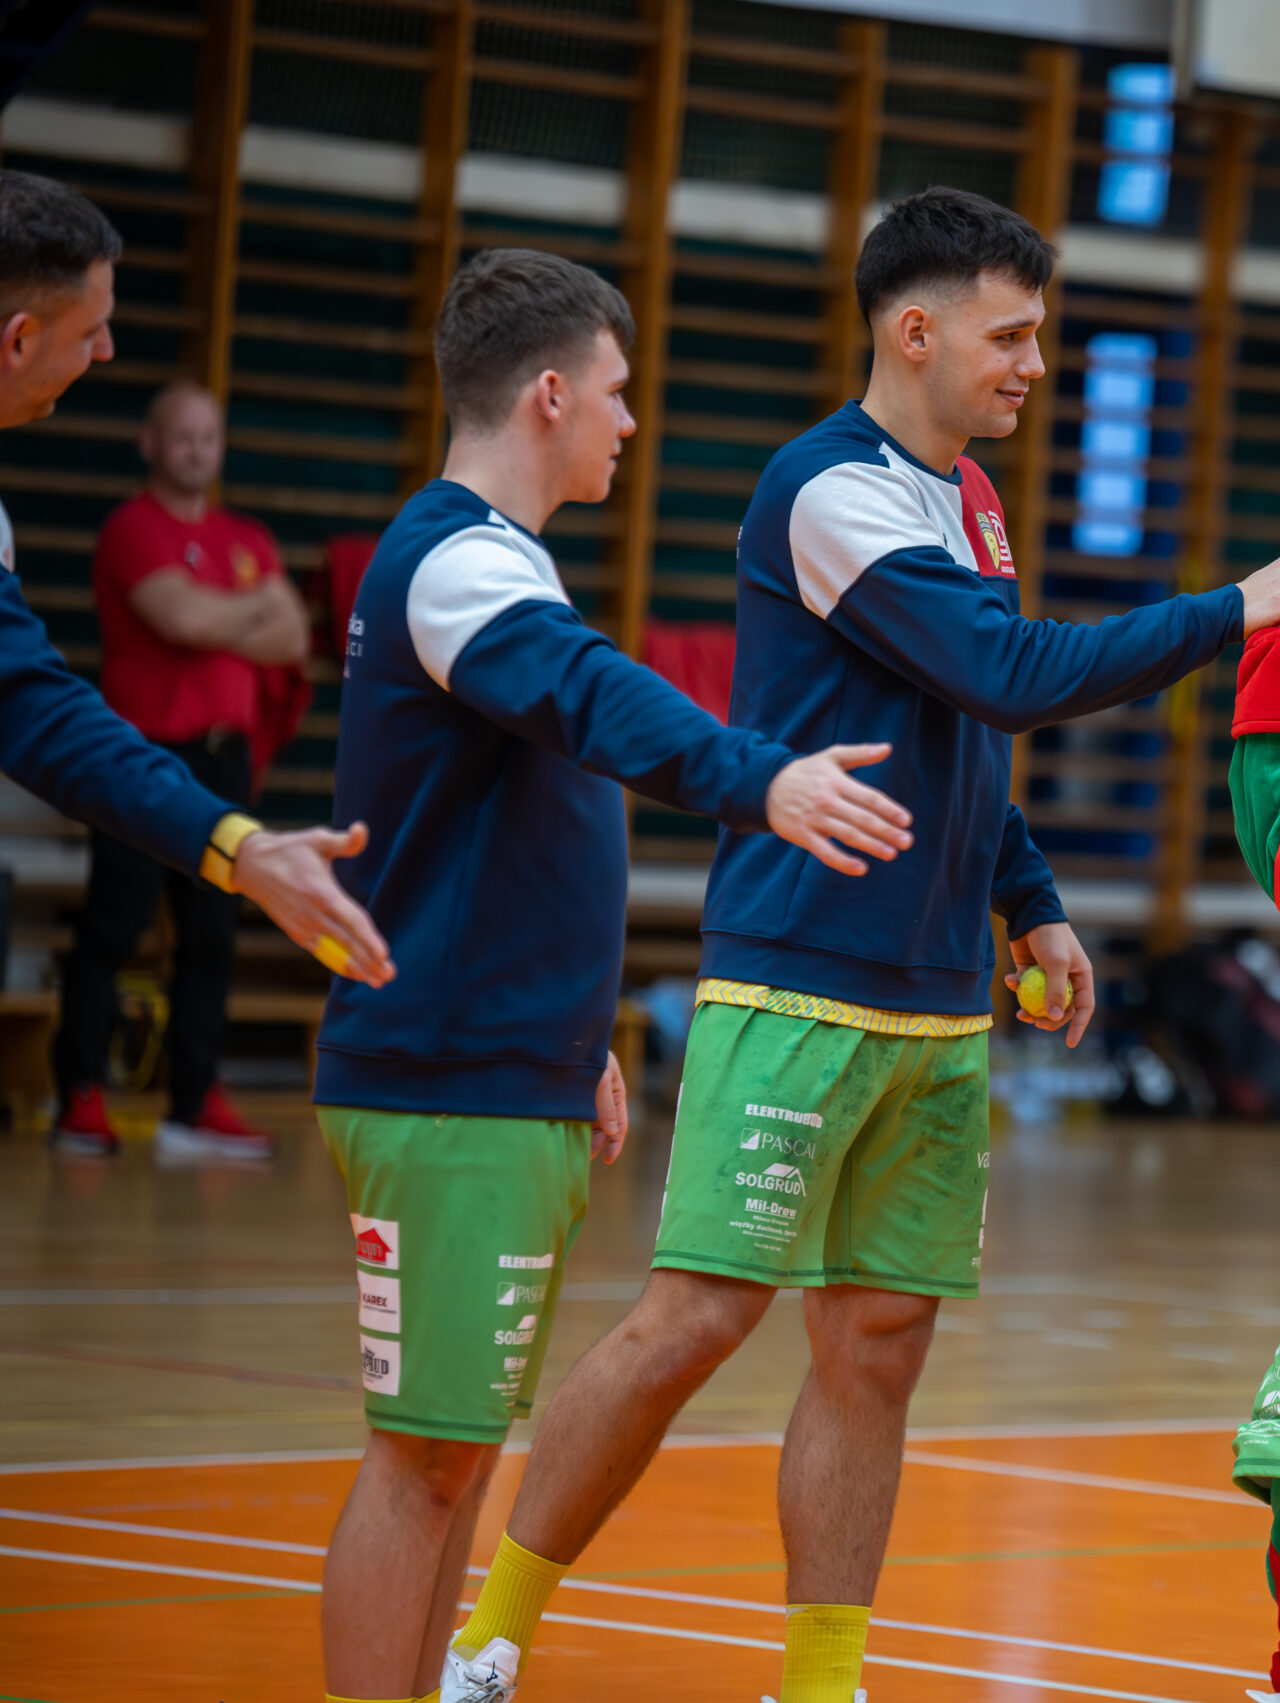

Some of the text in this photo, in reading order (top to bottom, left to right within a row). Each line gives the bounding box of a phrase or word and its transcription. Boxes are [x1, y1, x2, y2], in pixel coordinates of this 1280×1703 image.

[762, 1133, 816, 1160] PASCAL
[735, 1172, 801, 1195] SOLGRUD
[746, 1198, 797, 1217] Mil-Drew
